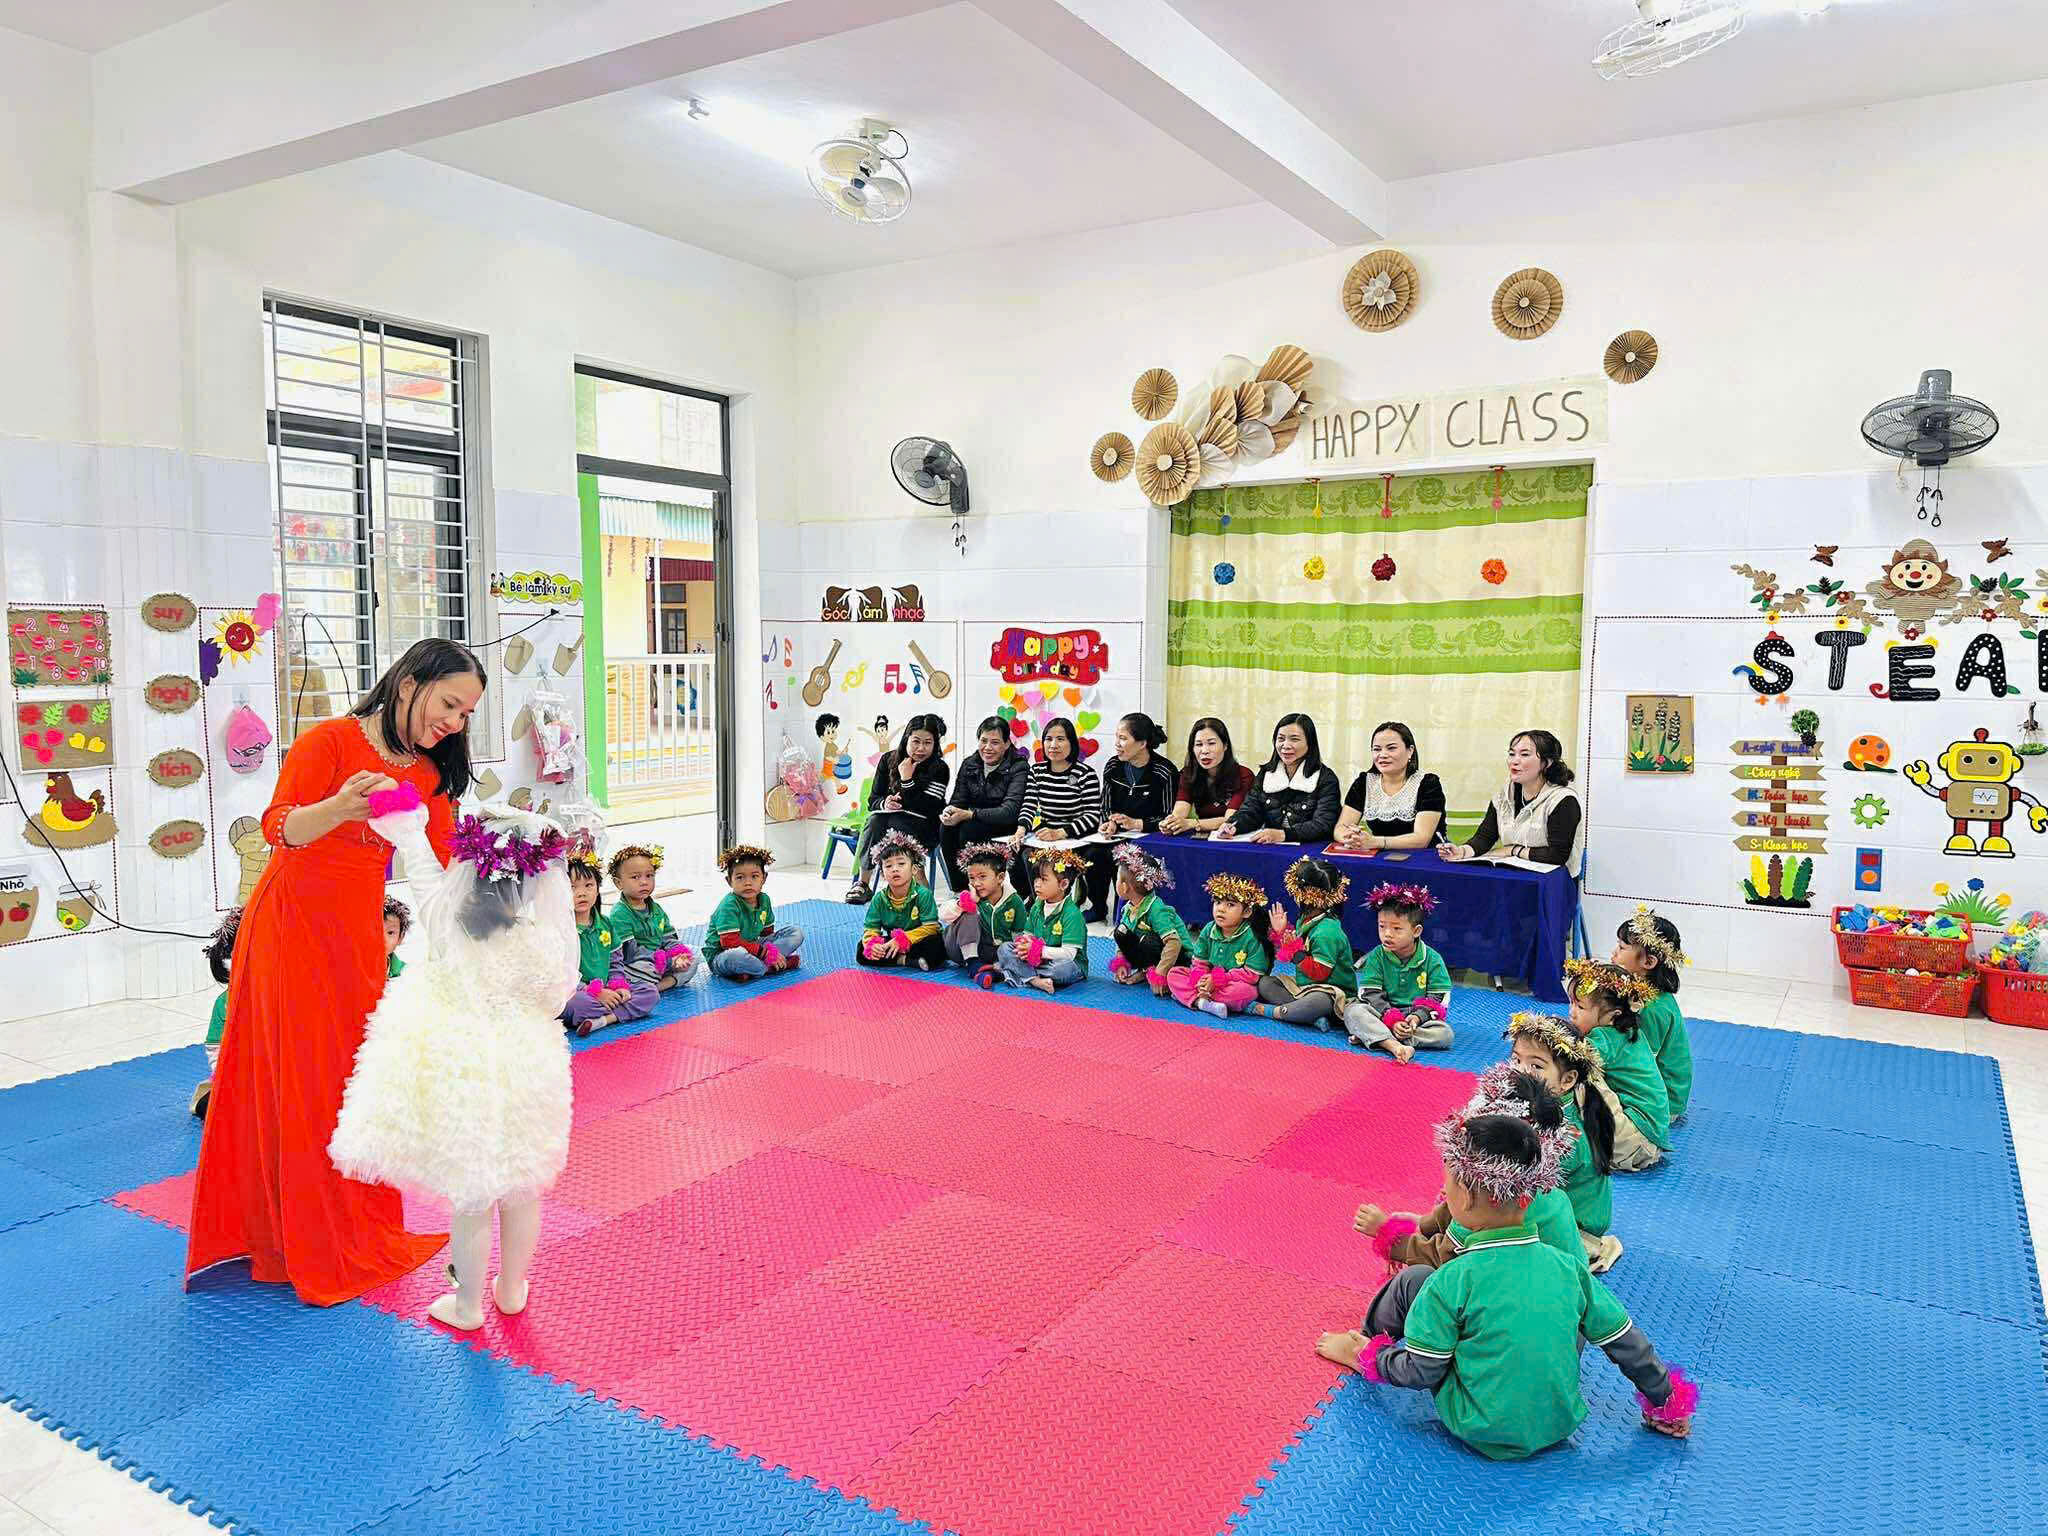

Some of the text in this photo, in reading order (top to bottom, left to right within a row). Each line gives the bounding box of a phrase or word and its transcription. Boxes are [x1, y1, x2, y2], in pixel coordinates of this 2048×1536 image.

[1312, 390, 1590, 460] HAPPY CLASS
[95, 613, 104, 626] 5
[152, 606, 184, 622] suy
[822, 605, 925, 621] Góc âm nhạc
[25, 617, 37, 632] 2
[59, 623, 70, 633] 4
[44, 637, 55, 651] 3
[73, 642, 82, 658] 7
[95, 639, 105, 653] 6
[1008, 631, 1089, 662] Happy
[29, 655, 37, 670] 1
[94, 657, 107, 671] 10
[1749, 628, 2048, 701] STEA
[51, 666, 62, 680] 8
[80, 667, 88, 681] 9
